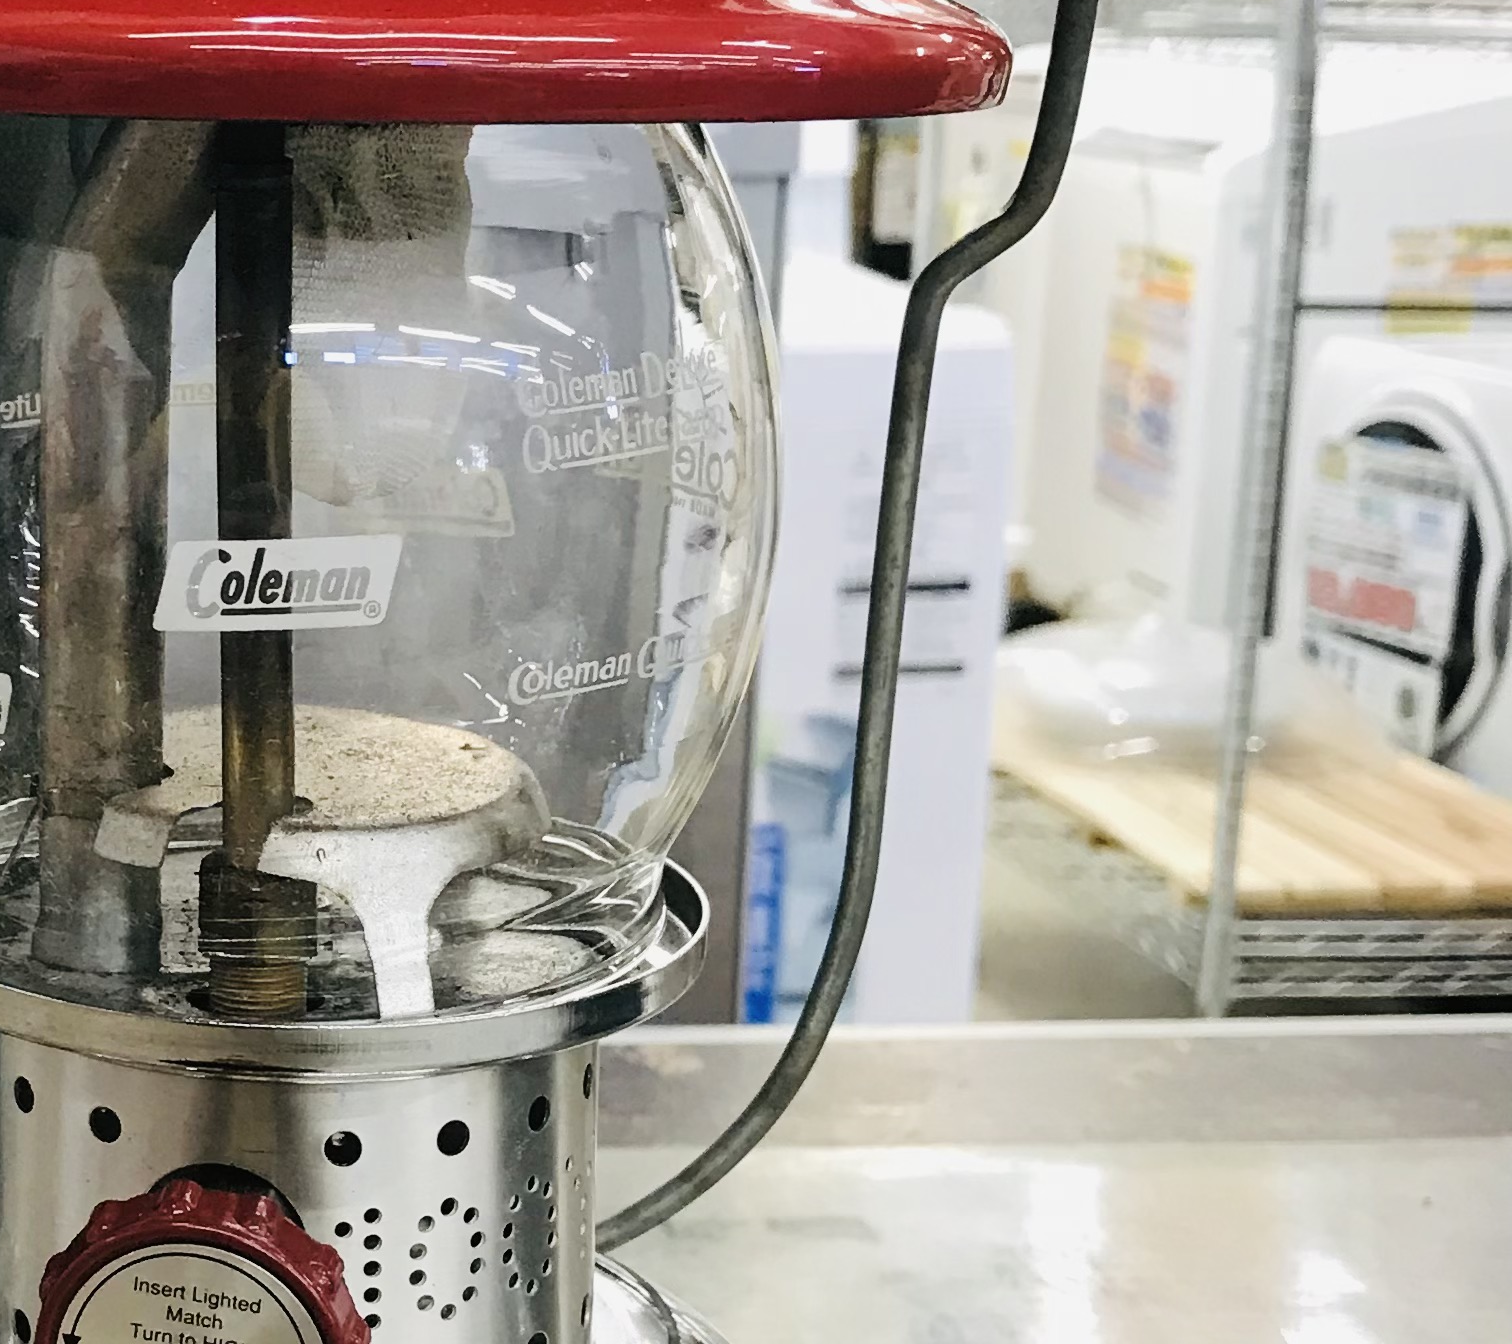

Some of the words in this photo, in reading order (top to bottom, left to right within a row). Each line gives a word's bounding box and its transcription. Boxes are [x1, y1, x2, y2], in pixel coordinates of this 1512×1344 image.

[517, 366, 638, 418] Coleman
[522, 408, 669, 473] Quick-Lite
[186, 547, 371, 619] Coleman
[507, 652, 631, 706] Coleman
[133, 1276, 187, 1301] Insert
[192, 1286, 262, 1314] Lighted
[165, 1306, 224, 1330] Match
